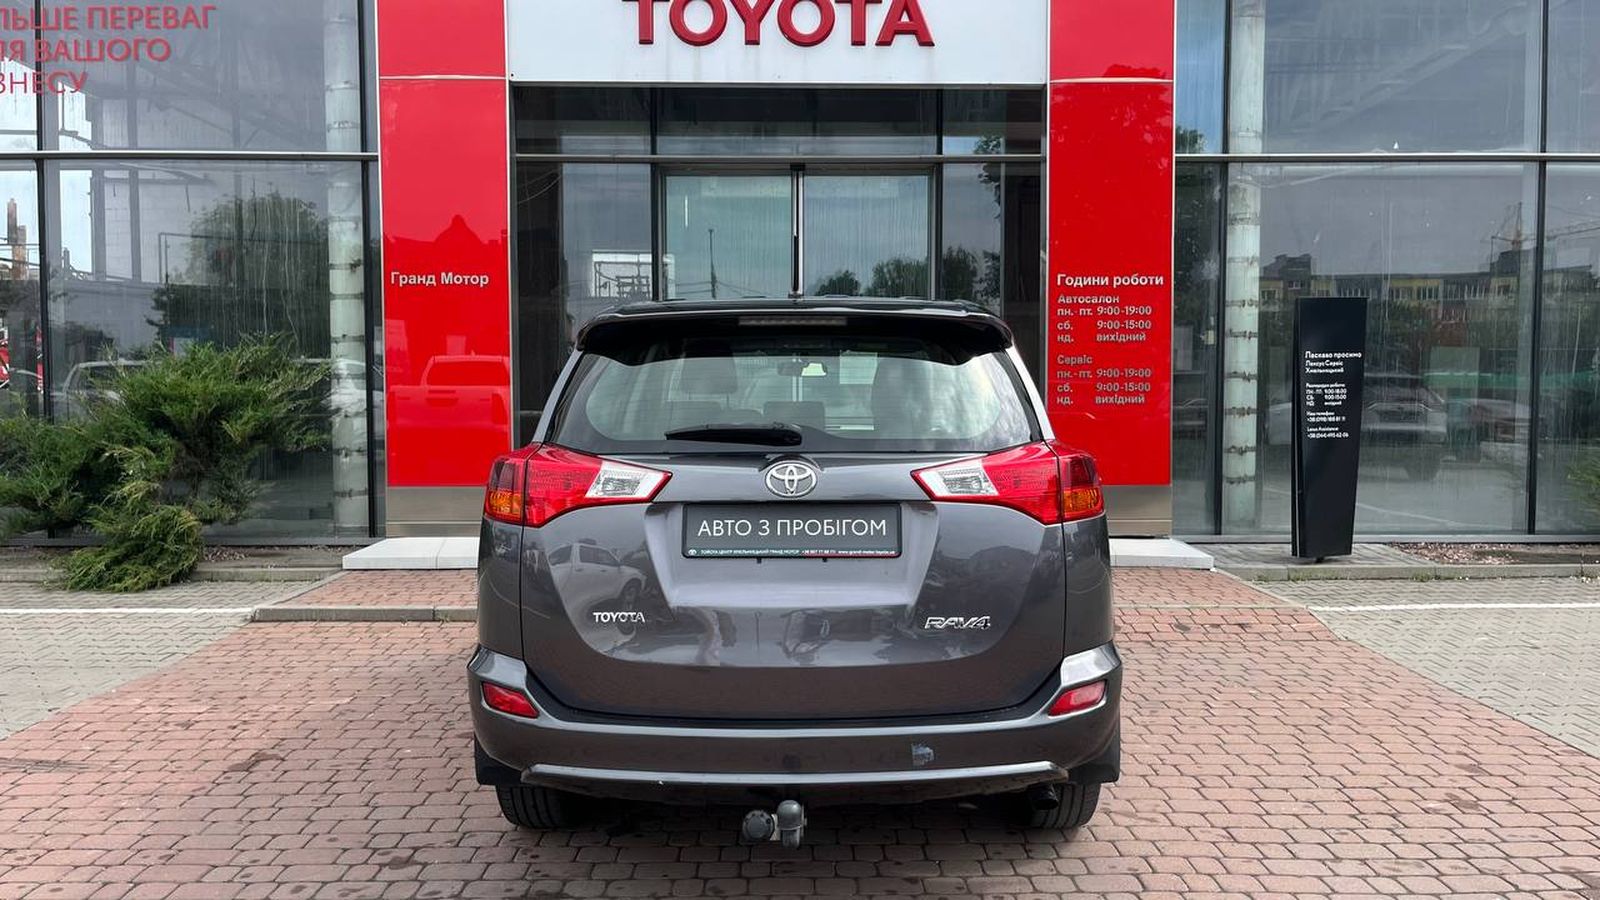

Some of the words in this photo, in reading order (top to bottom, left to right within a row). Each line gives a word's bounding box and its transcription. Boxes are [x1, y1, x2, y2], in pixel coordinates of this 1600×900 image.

[87, 5, 216, 30] ПЕРЕВАГ
[622, 0, 935, 47] TOYOTA
[35, 37, 172, 62] ВАШОГО
[390, 271, 437, 287] Гранд
[440, 271, 489, 287] Мотор
[1057, 273, 1109, 287] Години
[1113, 273, 1164, 288] роботи
[1058, 294, 1120, 304] Автосалон
[1057, 320, 1074, 330] сб.
[1097, 332, 1146, 342] вихідний
[1057, 354, 1093, 365] Сервіс
[1057, 382, 1073, 392] сб.
[1096, 394, 1145, 404] вихідний
[697, 519, 751, 536] АВТО
[777, 519, 886, 536] ПРОБІГОМ
[593, 612, 645, 623] TOYOTA
[925, 616, 990, 629] RAV4
